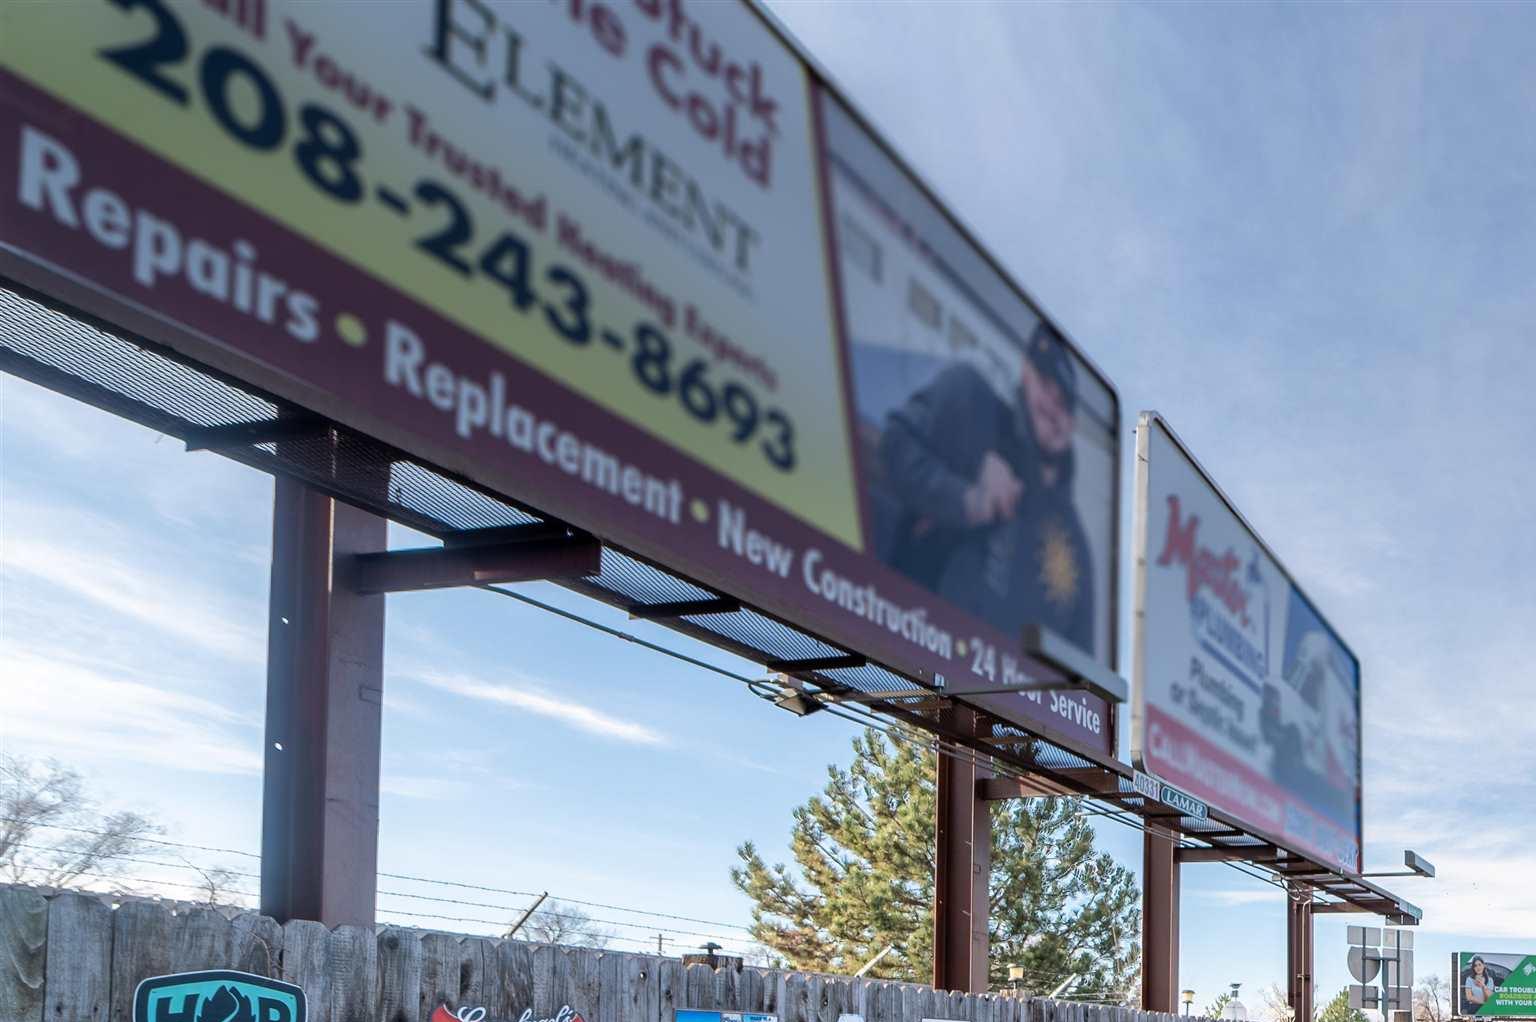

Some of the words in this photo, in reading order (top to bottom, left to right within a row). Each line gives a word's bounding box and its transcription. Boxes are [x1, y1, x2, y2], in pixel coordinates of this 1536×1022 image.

[93, 0, 798, 475] 208-243-8693
[285, 16, 396, 121] Your
[405, 105, 549, 234] Trusted
[418, 0, 760, 273] ELEMENT
[645, 42, 773, 190] Cold
[17, 122, 320, 343] Repairs
[384, 320, 683, 524] Replacement
[717, 499, 794, 579] New
[802, 549, 954, 660] Construction
[969, 637, 997, 683] 24
[1049, 690, 1101, 735] Service
[1166, 790, 1204, 817] LAMAR
